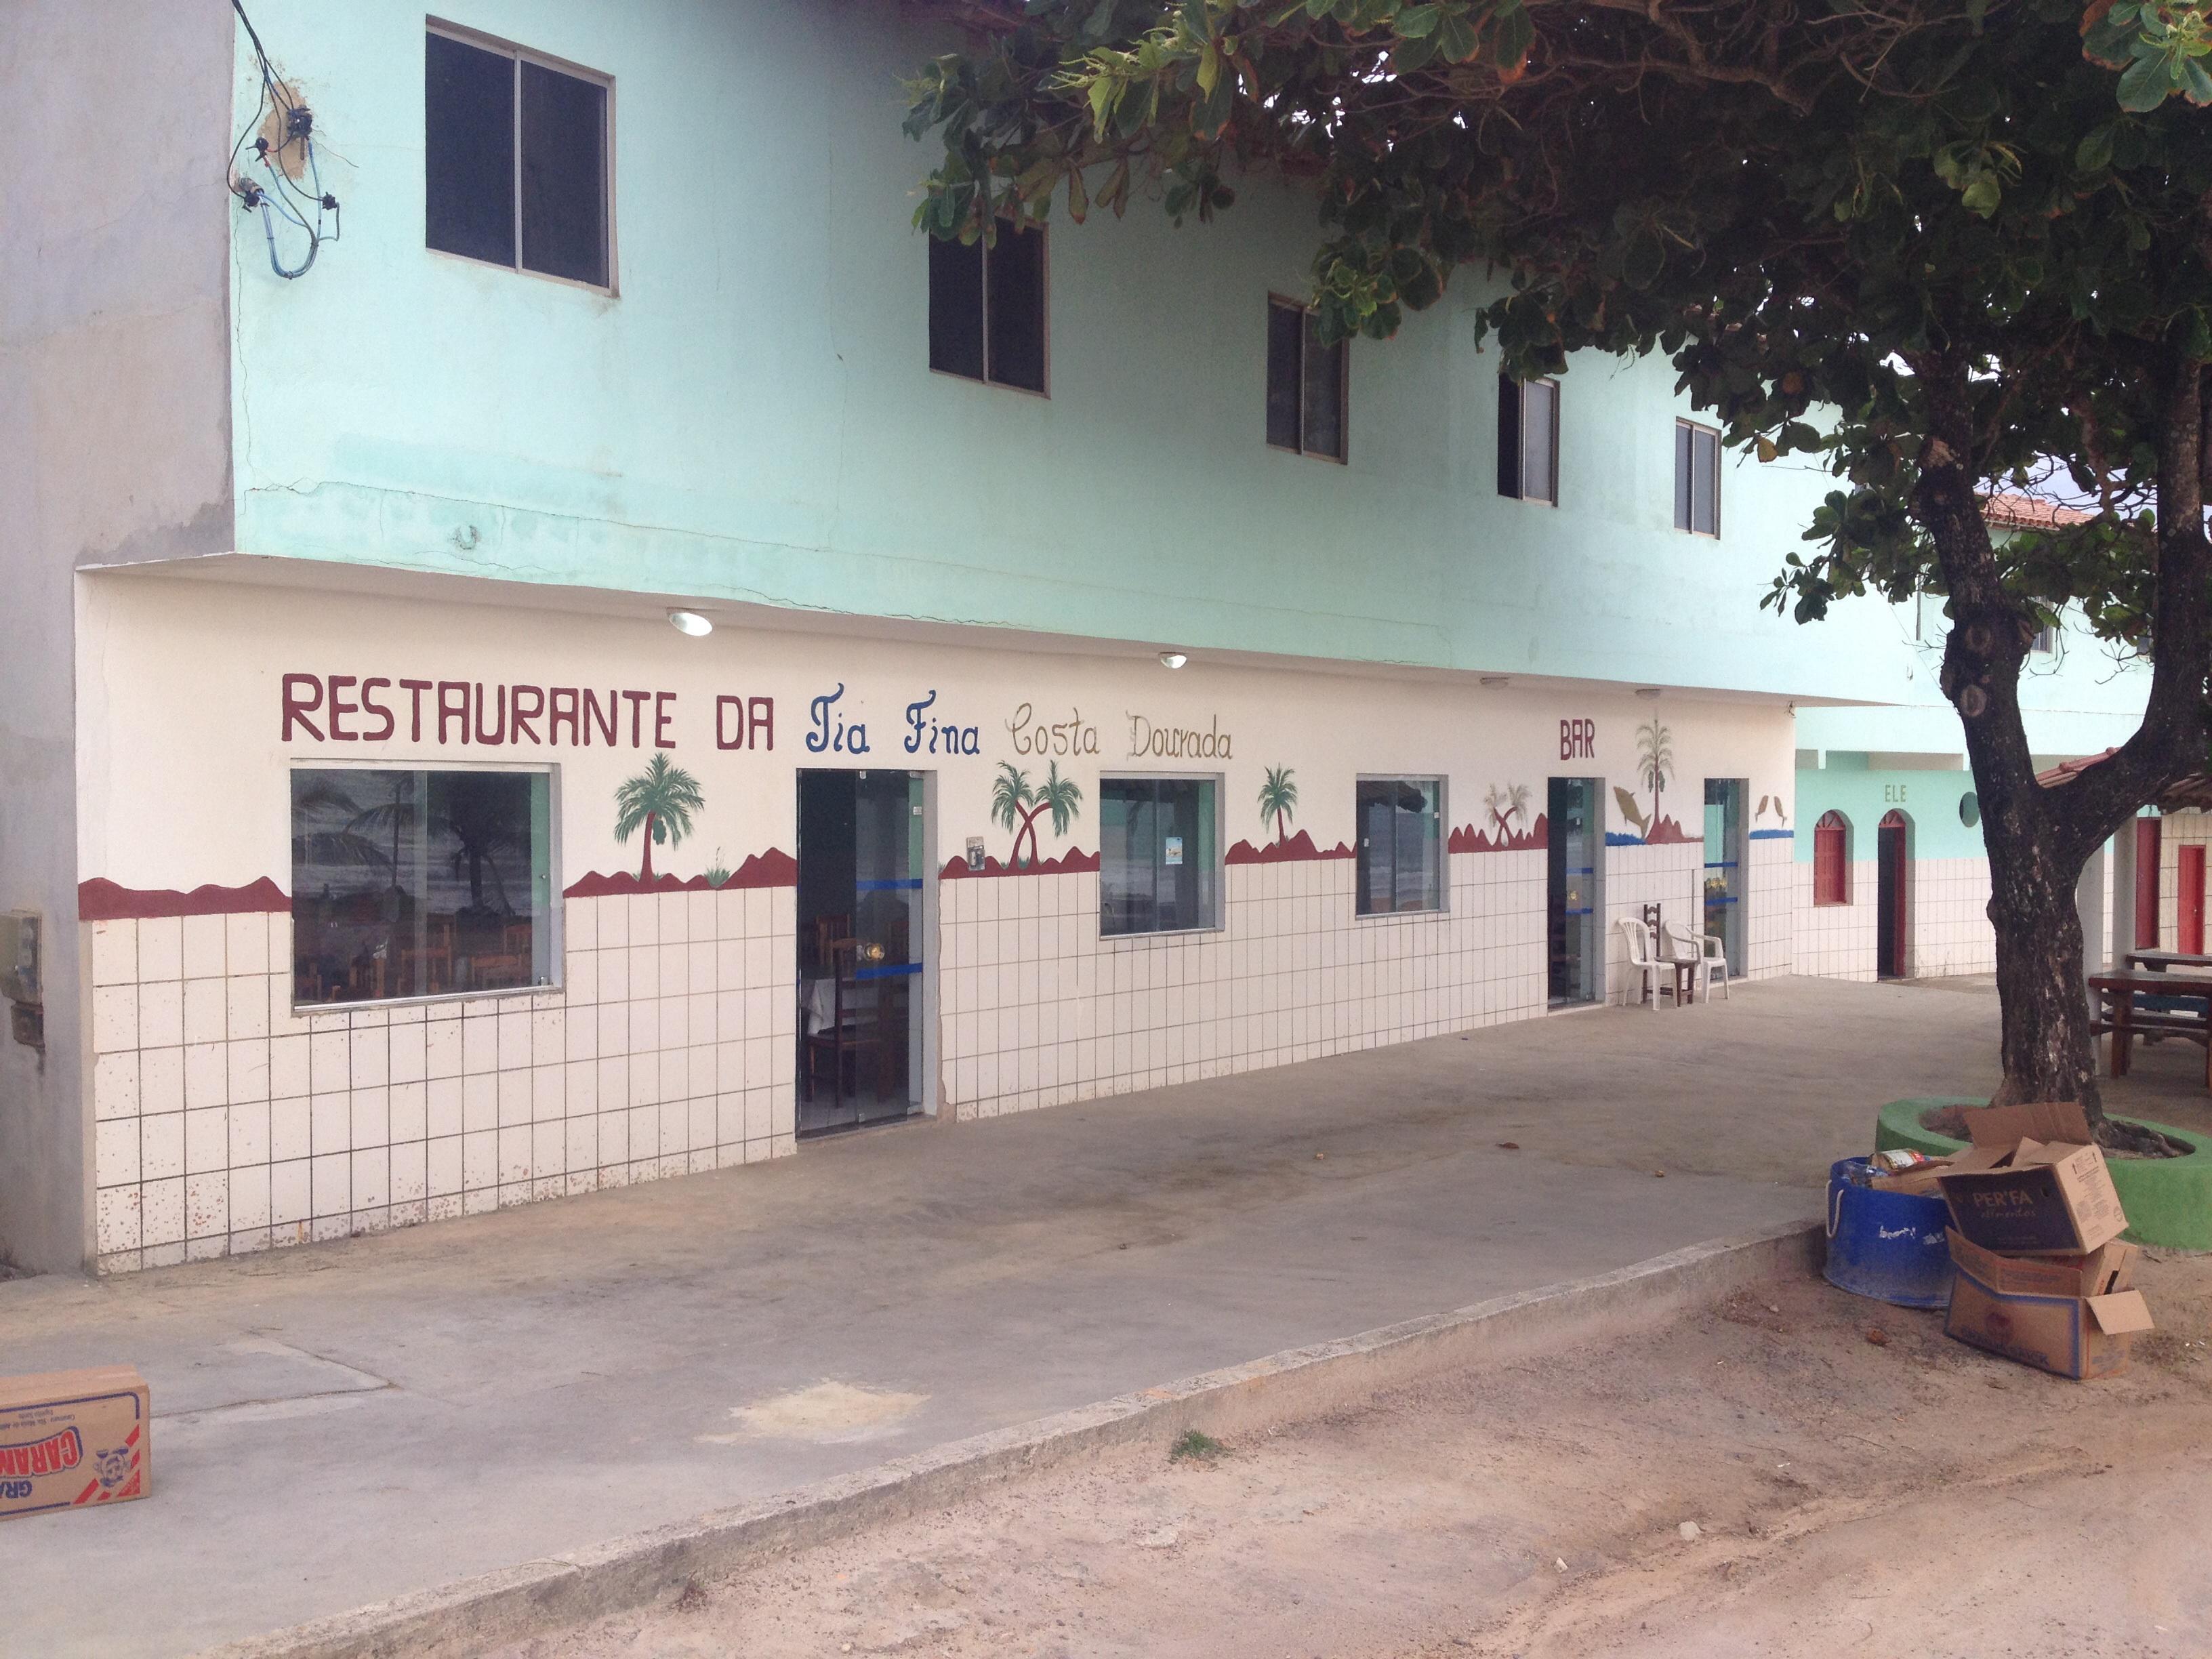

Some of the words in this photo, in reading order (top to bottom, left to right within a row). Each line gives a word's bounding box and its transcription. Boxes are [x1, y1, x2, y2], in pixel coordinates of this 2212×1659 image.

[281, 672, 676, 749] RESTAURANTE
[716, 695, 774, 752] DA
[805, 682, 870, 755] Tia
[904, 689, 980, 755] Fina
[1005, 702, 1100, 756] Costa
[1126, 709, 1233, 761] Dourada
[1560, 718, 1595, 761] BAR
[1884, 783, 1907, 803] ELE
